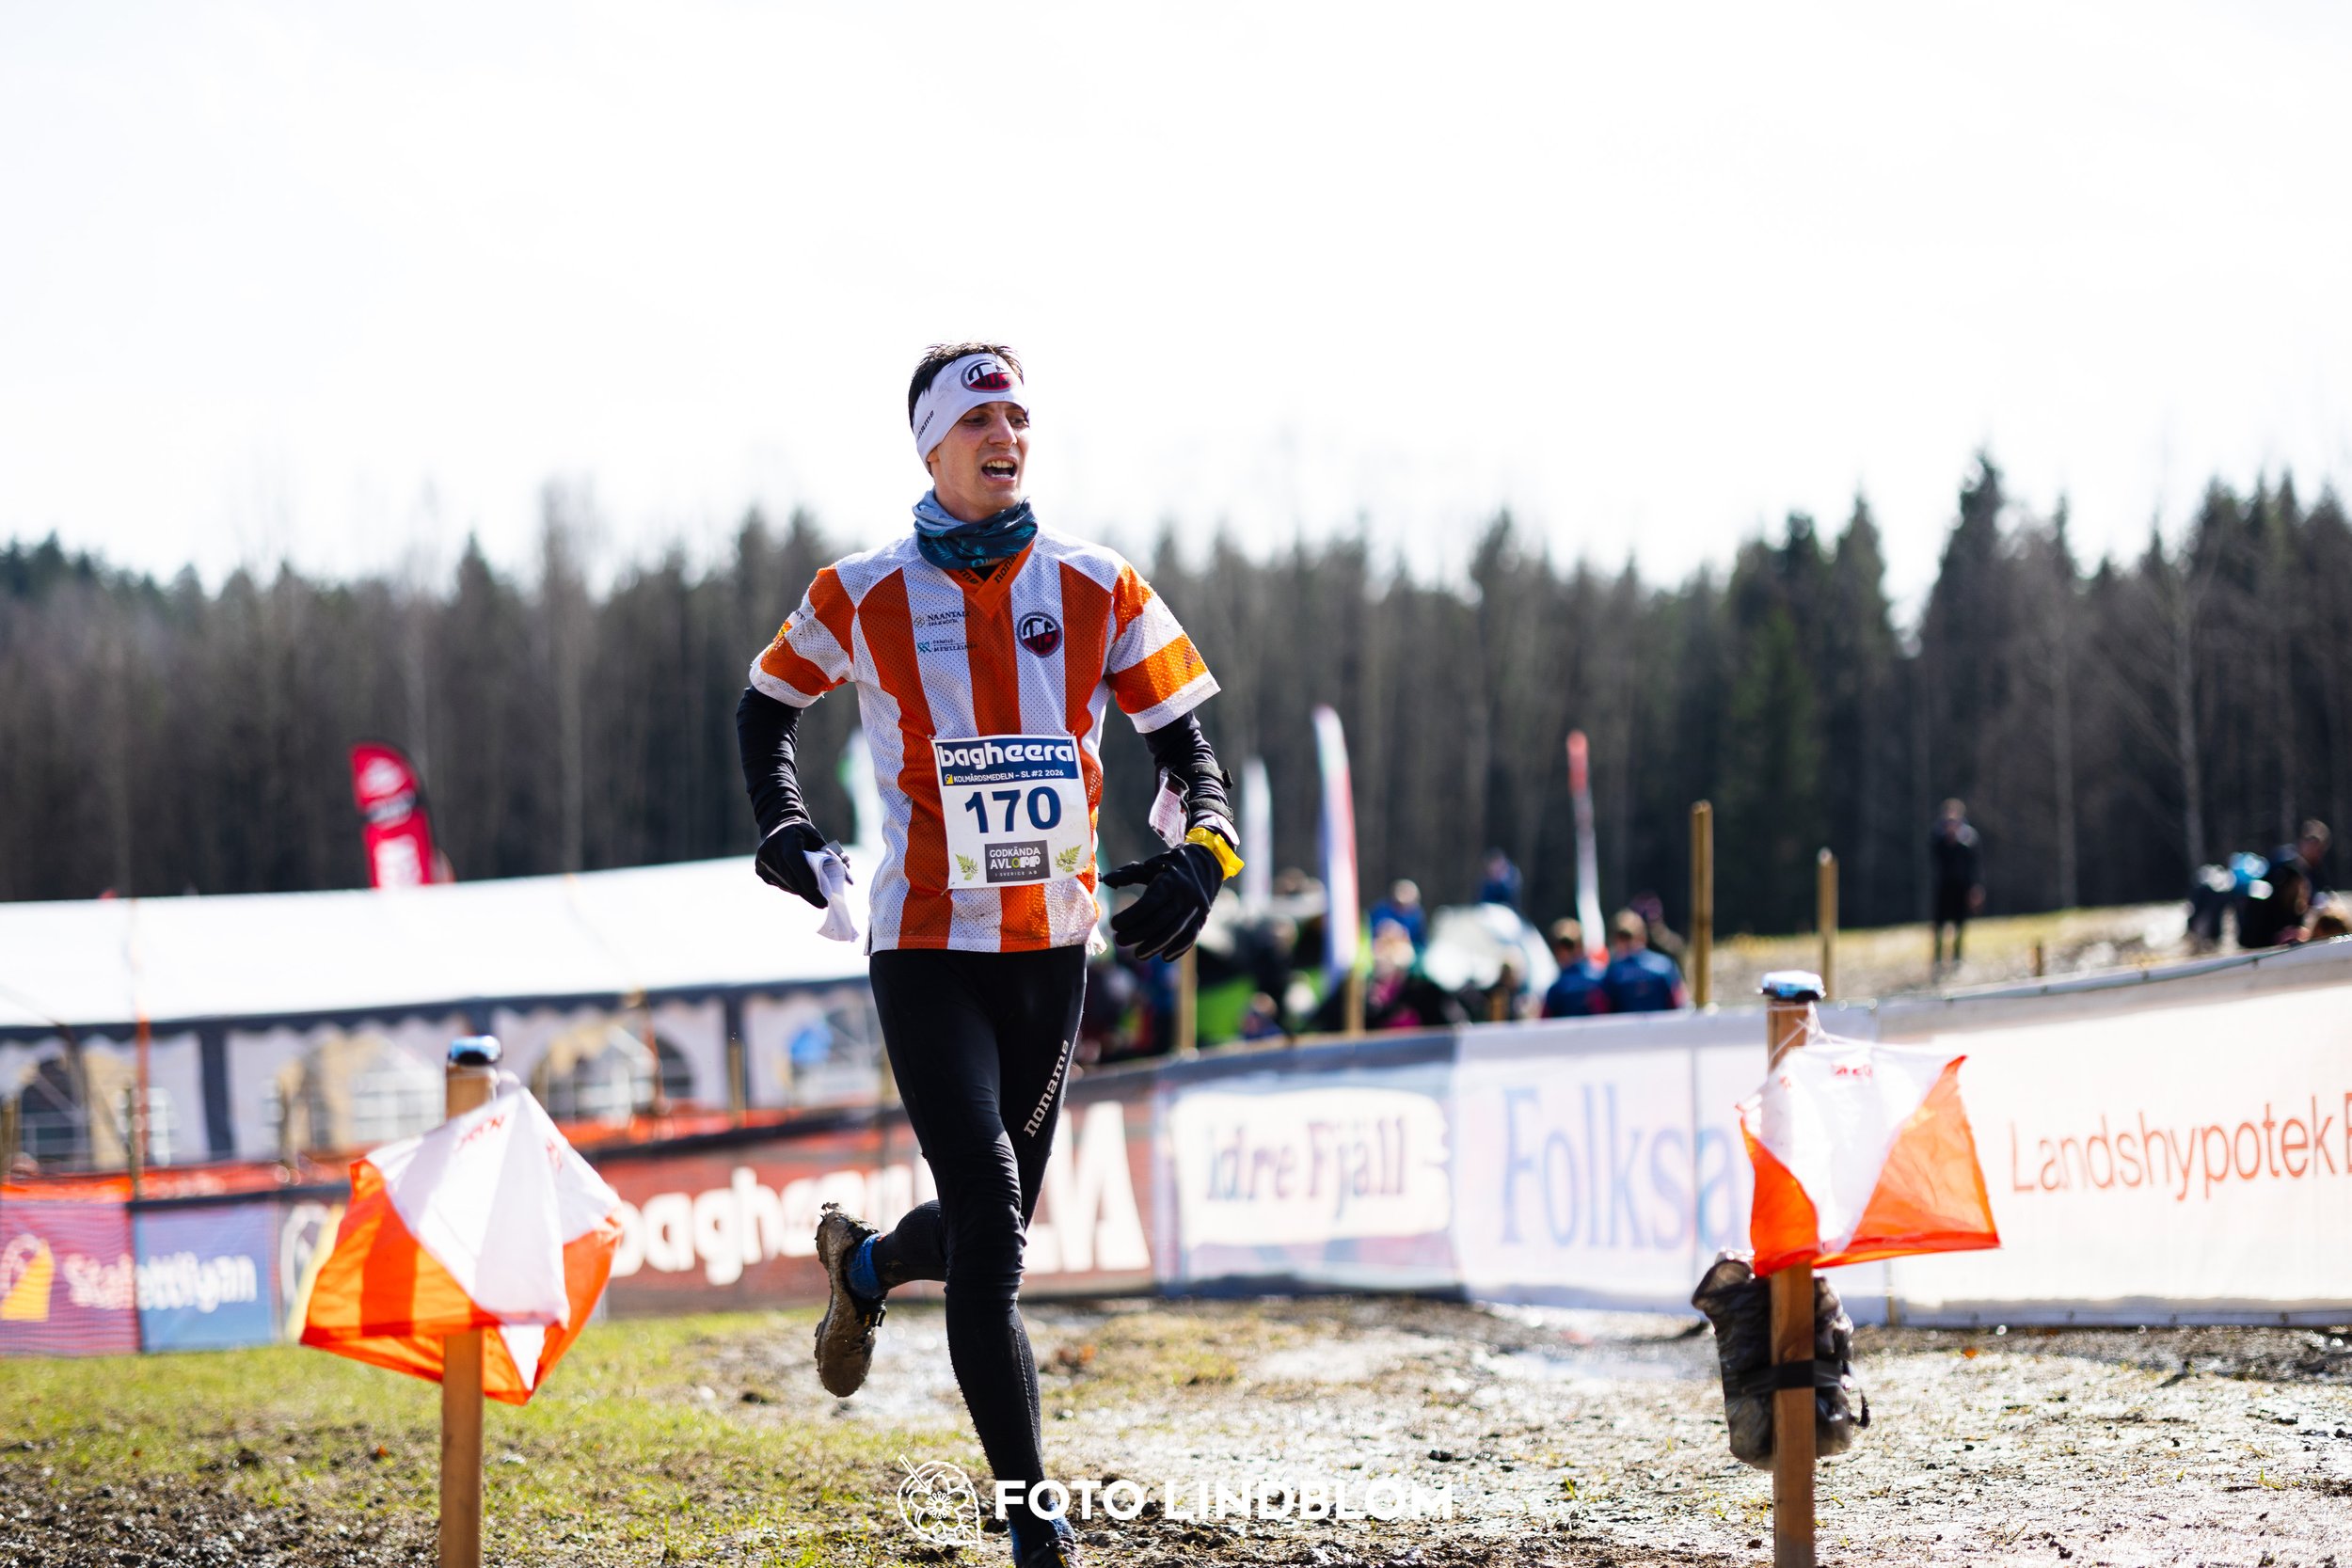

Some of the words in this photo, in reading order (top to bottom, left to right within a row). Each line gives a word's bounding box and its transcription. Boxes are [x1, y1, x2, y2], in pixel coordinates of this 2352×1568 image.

[994, 553, 1019, 583] nona
[937, 742, 1074, 770] bagheera
[953, 772, 1014, 784] KOLMÅRDSMEDELN
[964, 786, 1062, 834] 170
[989, 847, 1041, 858] GODKÄNDA
[1024, 1039, 1070, 1137] noname
[2009, 1094, 2337, 1201] Landshypotek
